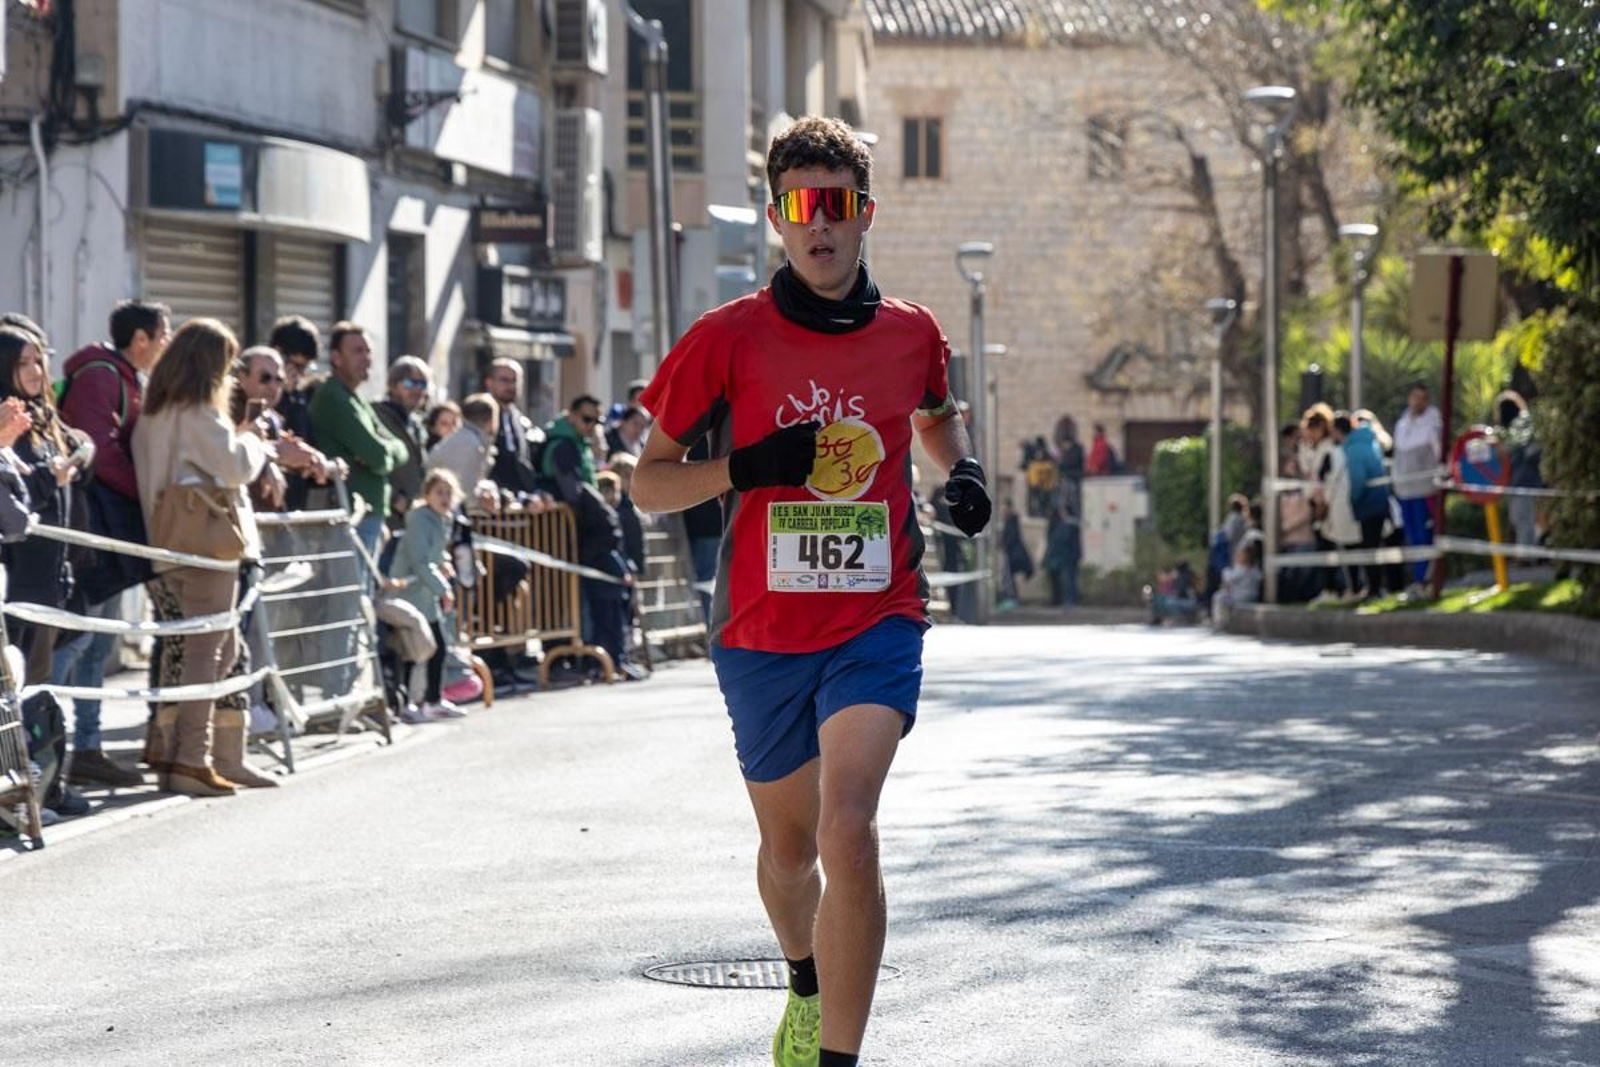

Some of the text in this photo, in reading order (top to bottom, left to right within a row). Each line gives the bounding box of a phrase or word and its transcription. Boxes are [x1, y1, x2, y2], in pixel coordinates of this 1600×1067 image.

[792, 506, 808, 517] SAN
[810, 506, 831, 517] JUAN
[788, 518, 819, 530] CARRERA
[820, 518, 850, 530] POPULAR
[798, 534, 865, 570] 462
